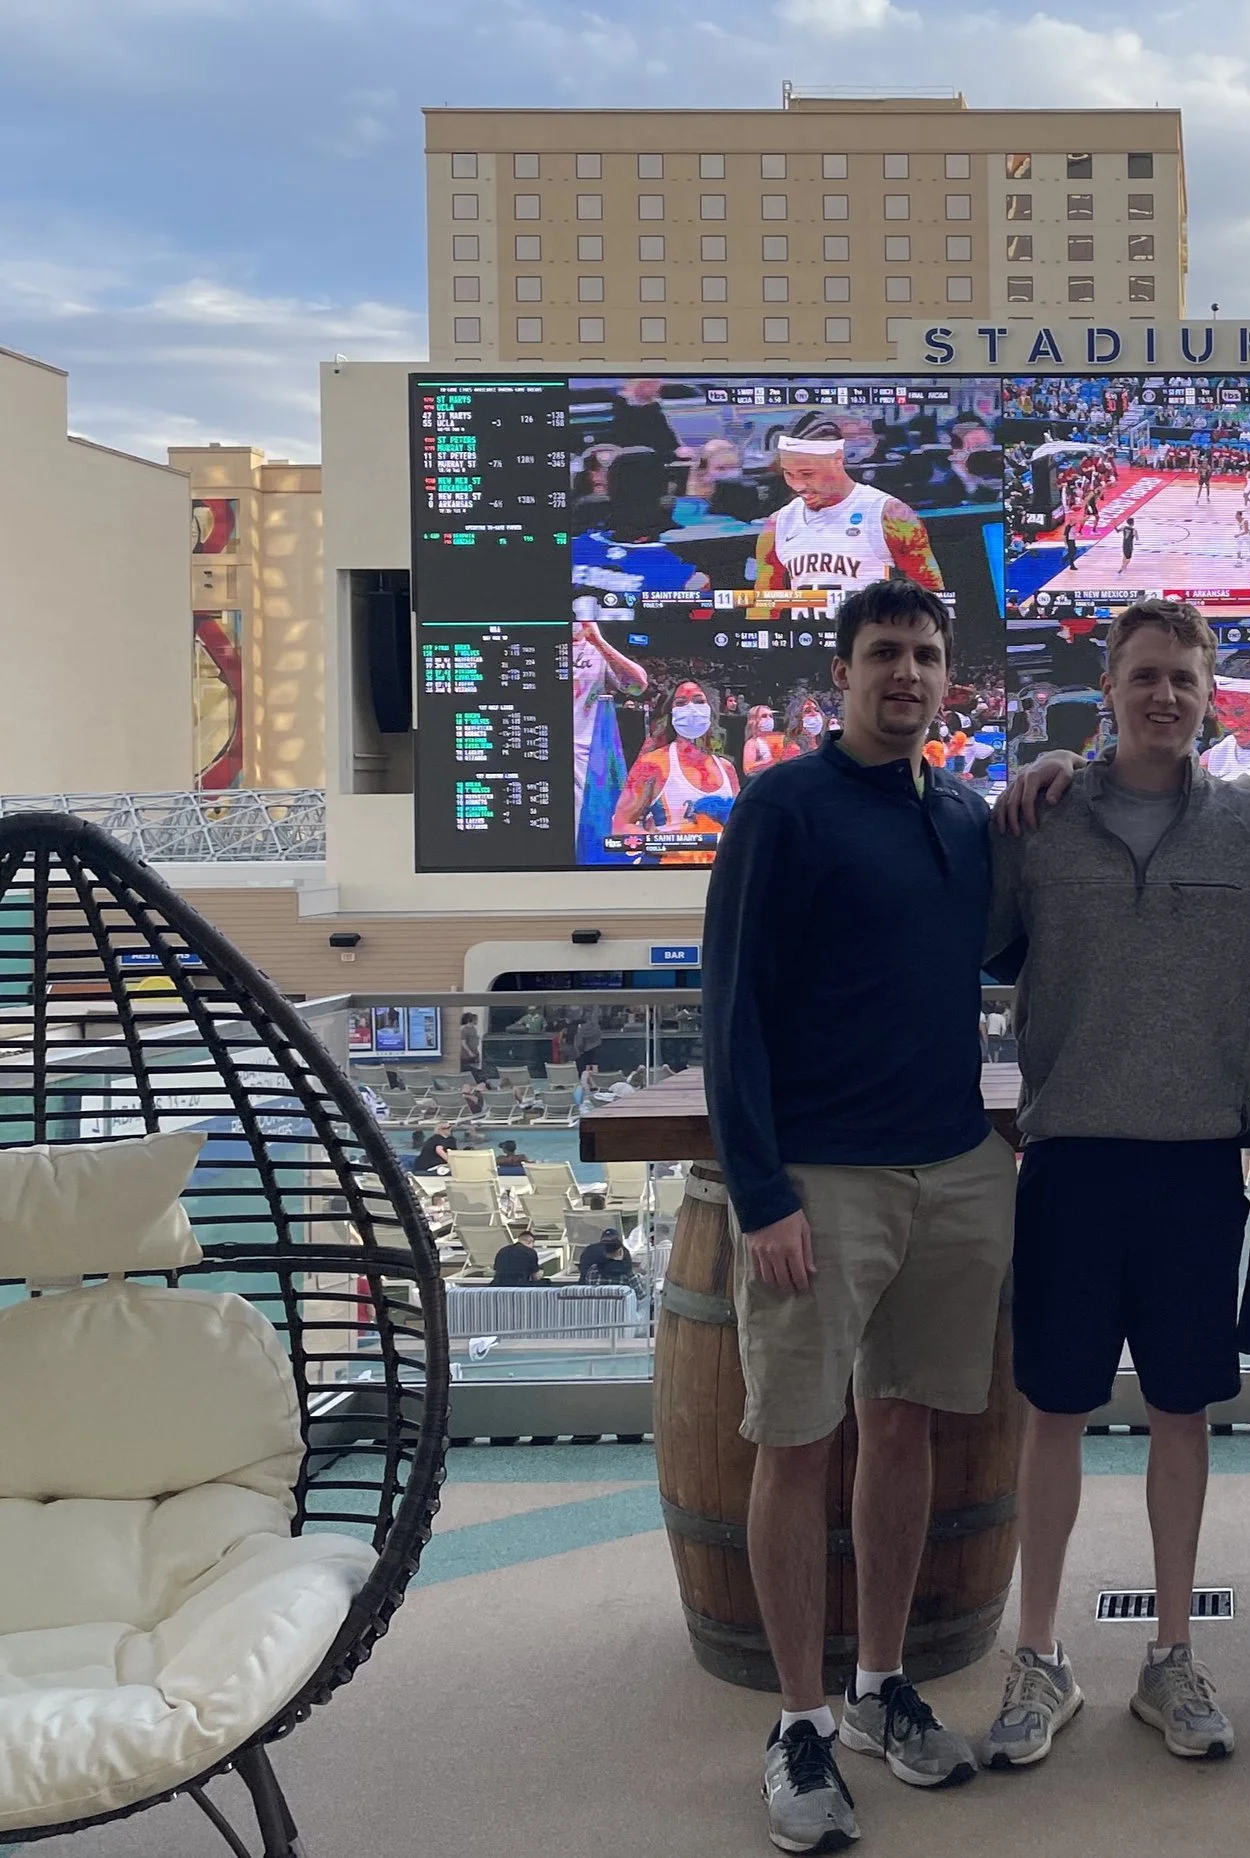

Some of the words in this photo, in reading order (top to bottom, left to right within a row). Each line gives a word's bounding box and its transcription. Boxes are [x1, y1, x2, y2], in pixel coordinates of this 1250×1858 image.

[709, 392, 726, 400] tbs
[1223, 391, 1239, 399] tbs
[437, 396, 446, 404] ST
[422, 412, 432, 420] 47
[437, 412, 446, 420] ST
[449, 412, 472, 420] MARYS
[424, 460, 432, 468] 11
[437, 460, 463, 468] MURRAY
[467, 460, 476, 468] ST
[438, 477, 452, 485] NEW
[455, 477, 469, 485] MEX
[472, 477, 481, 485] ST
[642, 591, 648, 599] 15
[651, 591, 671, 599] SAINT
[673, 591, 700, 599] PETER'S
[718, 593, 730, 604] 11
[654, 834, 675, 842] SAINT
[677, 834, 703, 842] MARY'S
[605, 839, 622, 848] tbs
[664, 951, 685, 959] BAR
